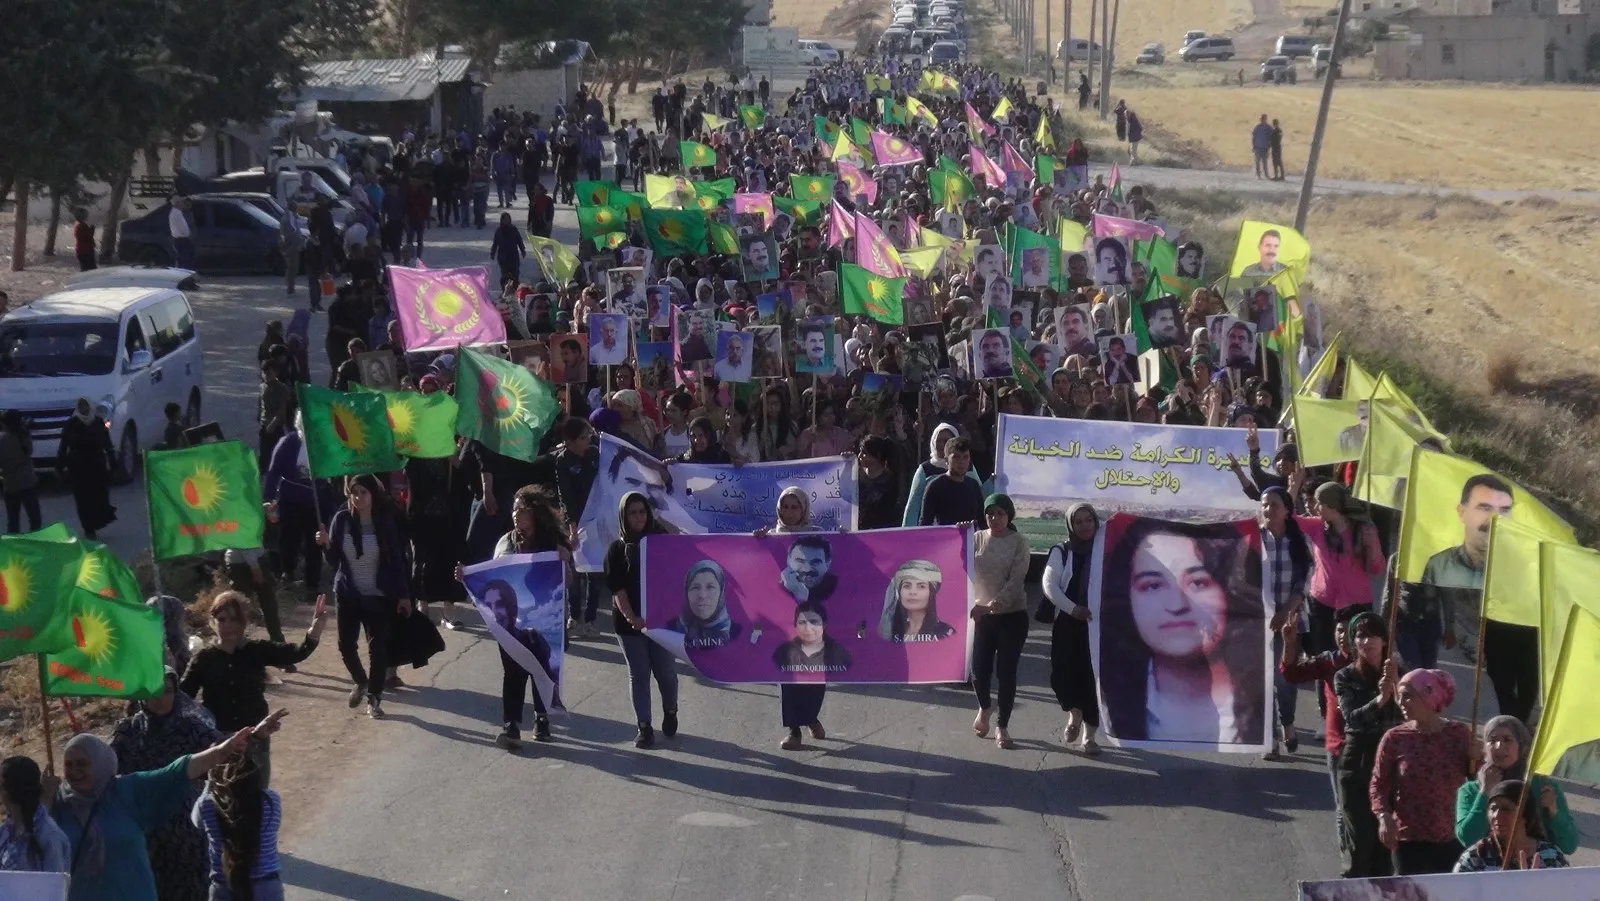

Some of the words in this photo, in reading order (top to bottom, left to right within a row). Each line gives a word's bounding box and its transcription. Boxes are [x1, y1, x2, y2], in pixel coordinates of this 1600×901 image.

[1007, 434, 1081, 461] الخيانة
[1085, 443, 1124, 461] ضد
[1130, 442, 1202, 468] الكرامة
[721, 485, 747, 500] هذه
[825, 486, 842, 499] قد
[903, 633, 939, 642] ZEHRA
[809, 664, 847, 673] QEHRAMAN
